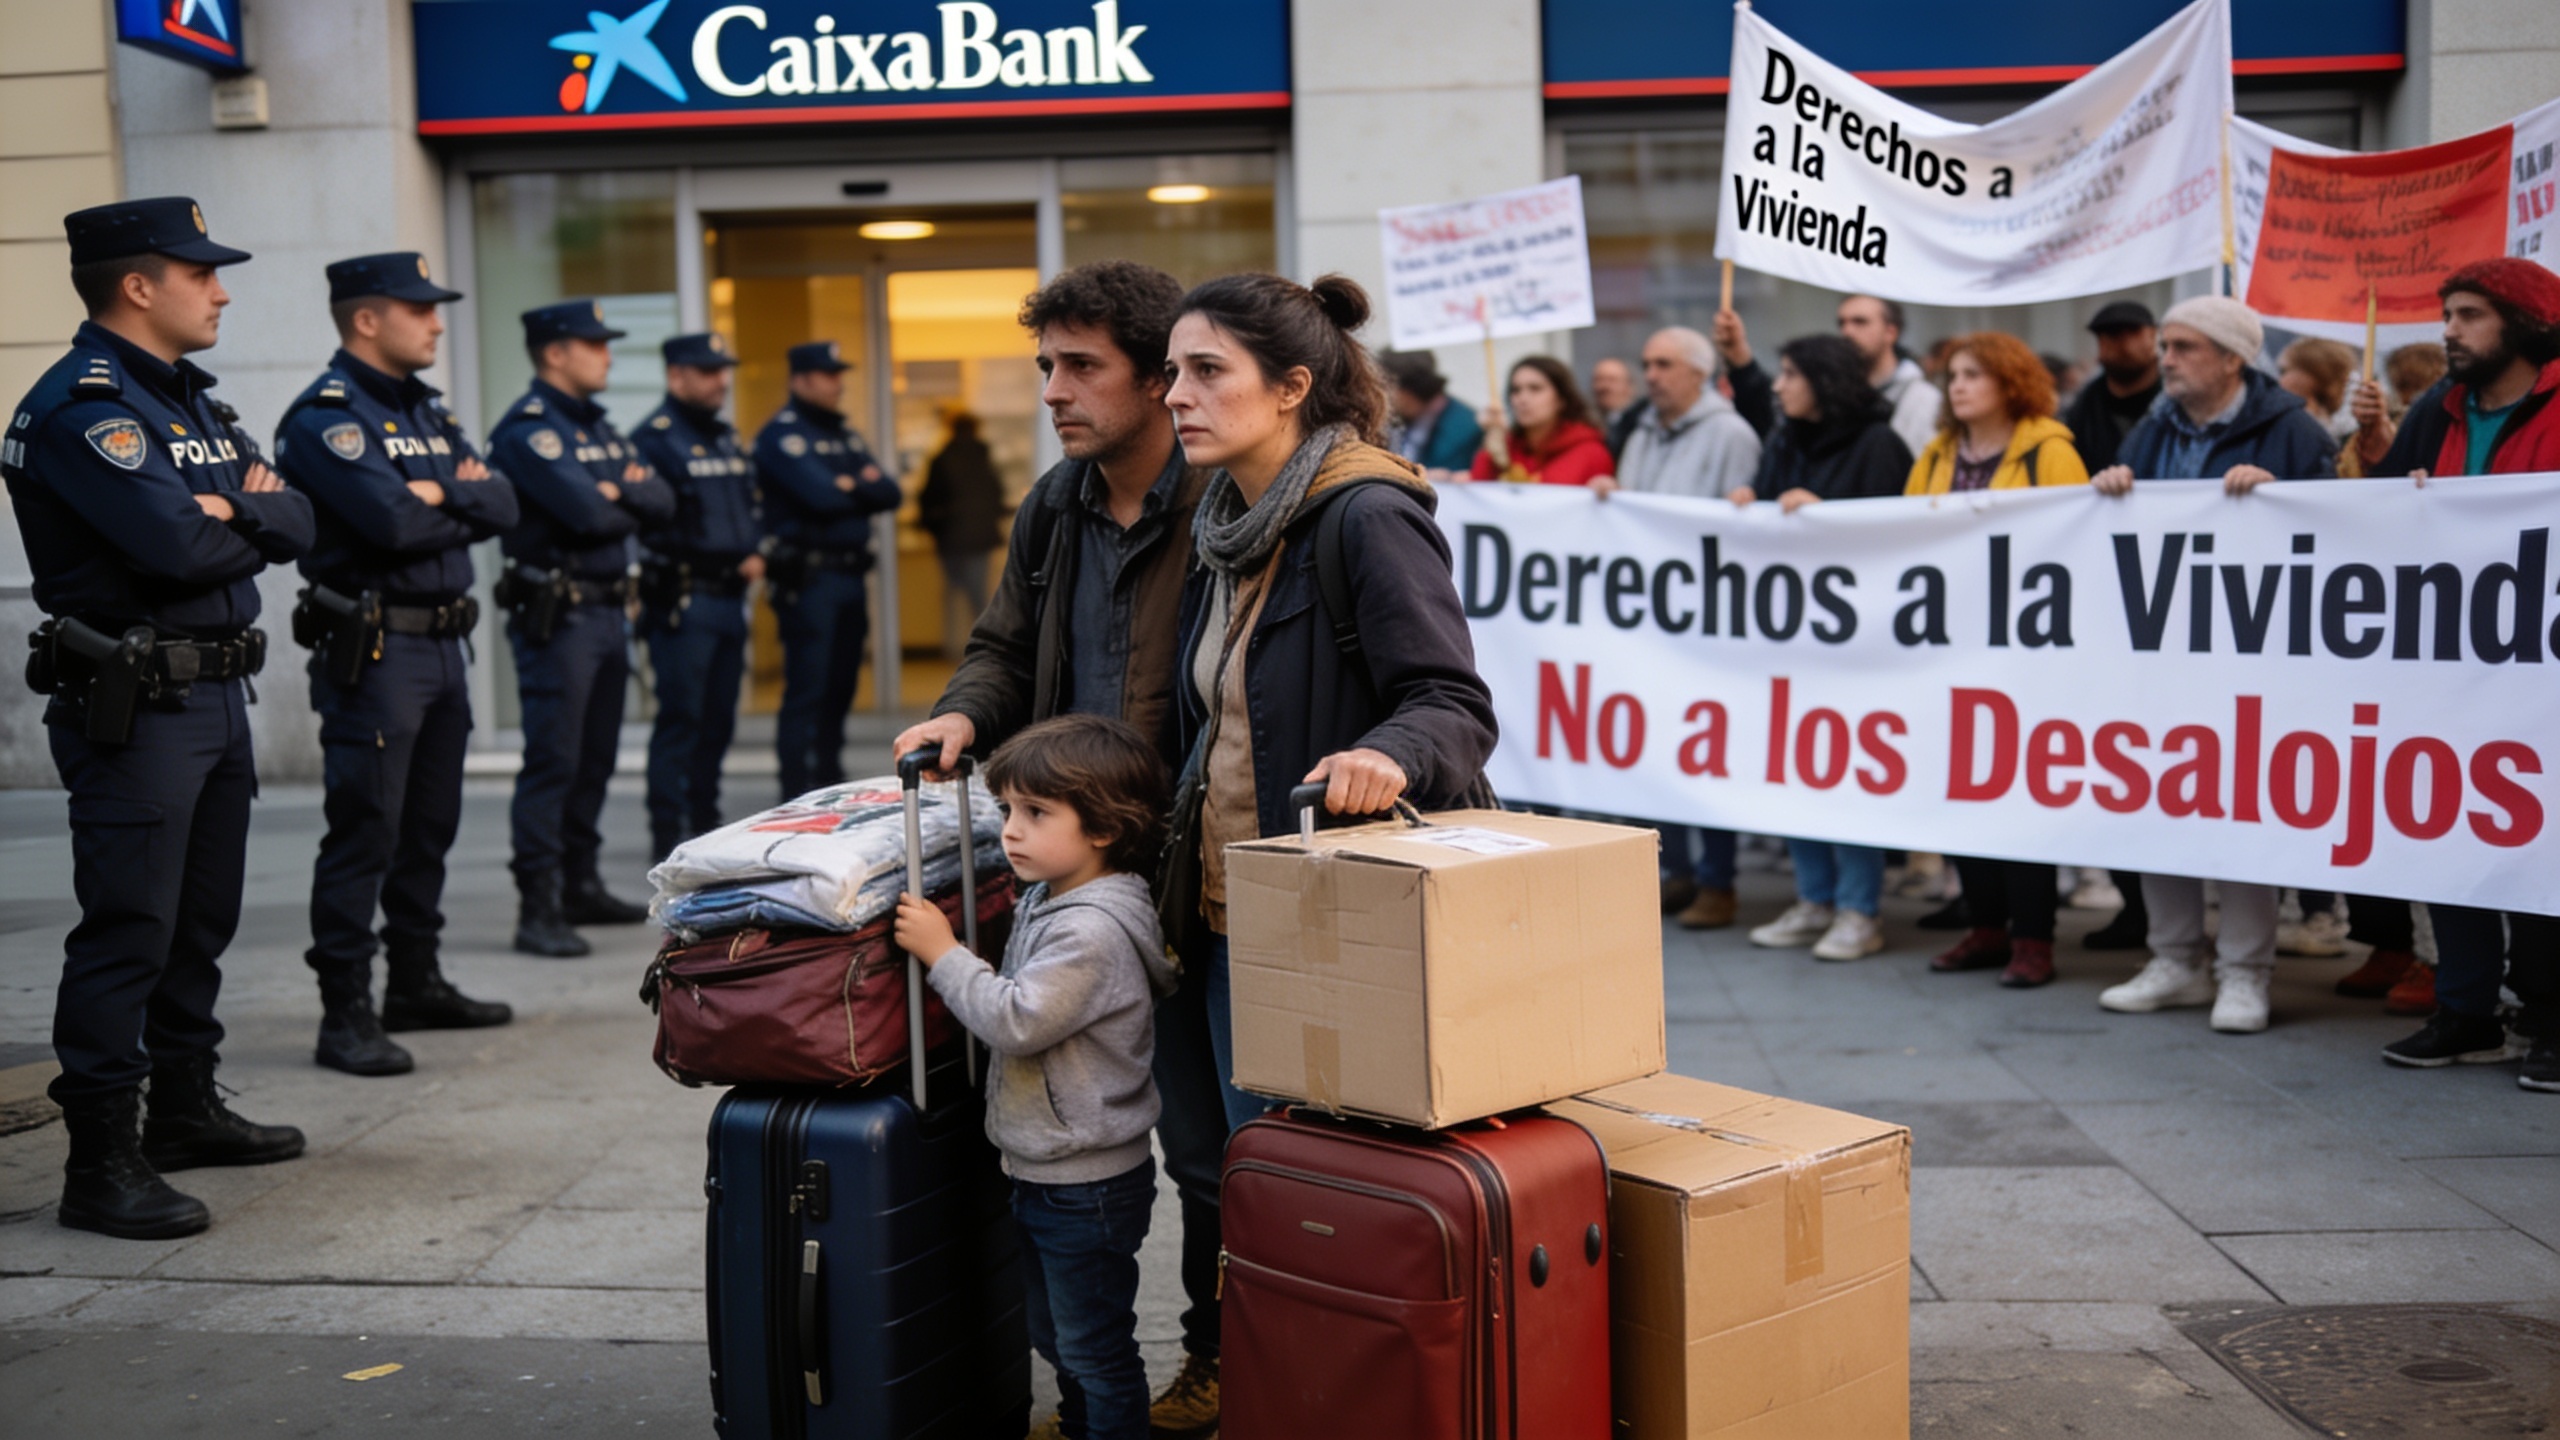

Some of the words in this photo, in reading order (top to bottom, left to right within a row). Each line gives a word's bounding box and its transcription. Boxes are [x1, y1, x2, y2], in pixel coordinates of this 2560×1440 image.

[691, 0, 1155, 97] CaixaBank
[1752, 123, 1777, 166] a
[1790, 122, 1826, 182] la
[1760, 46, 1968, 198] Derechos
[1987, 165, 2014, 200] a
[1733, 174, 1889, 269] Vivienda
[1462, 522, 1859, 645] Derechos
[1891, 564, 1951, 649] a
[1987, 533, 2075, 650] la
[2110, 526, 2560, 666] Viviend
[1536, 660, 1647, 770] No
[1677, 699, 1729, 778] a
[1765, 676, 1908, 797] los
[1945, 686, 2545, 868] Desalojos
